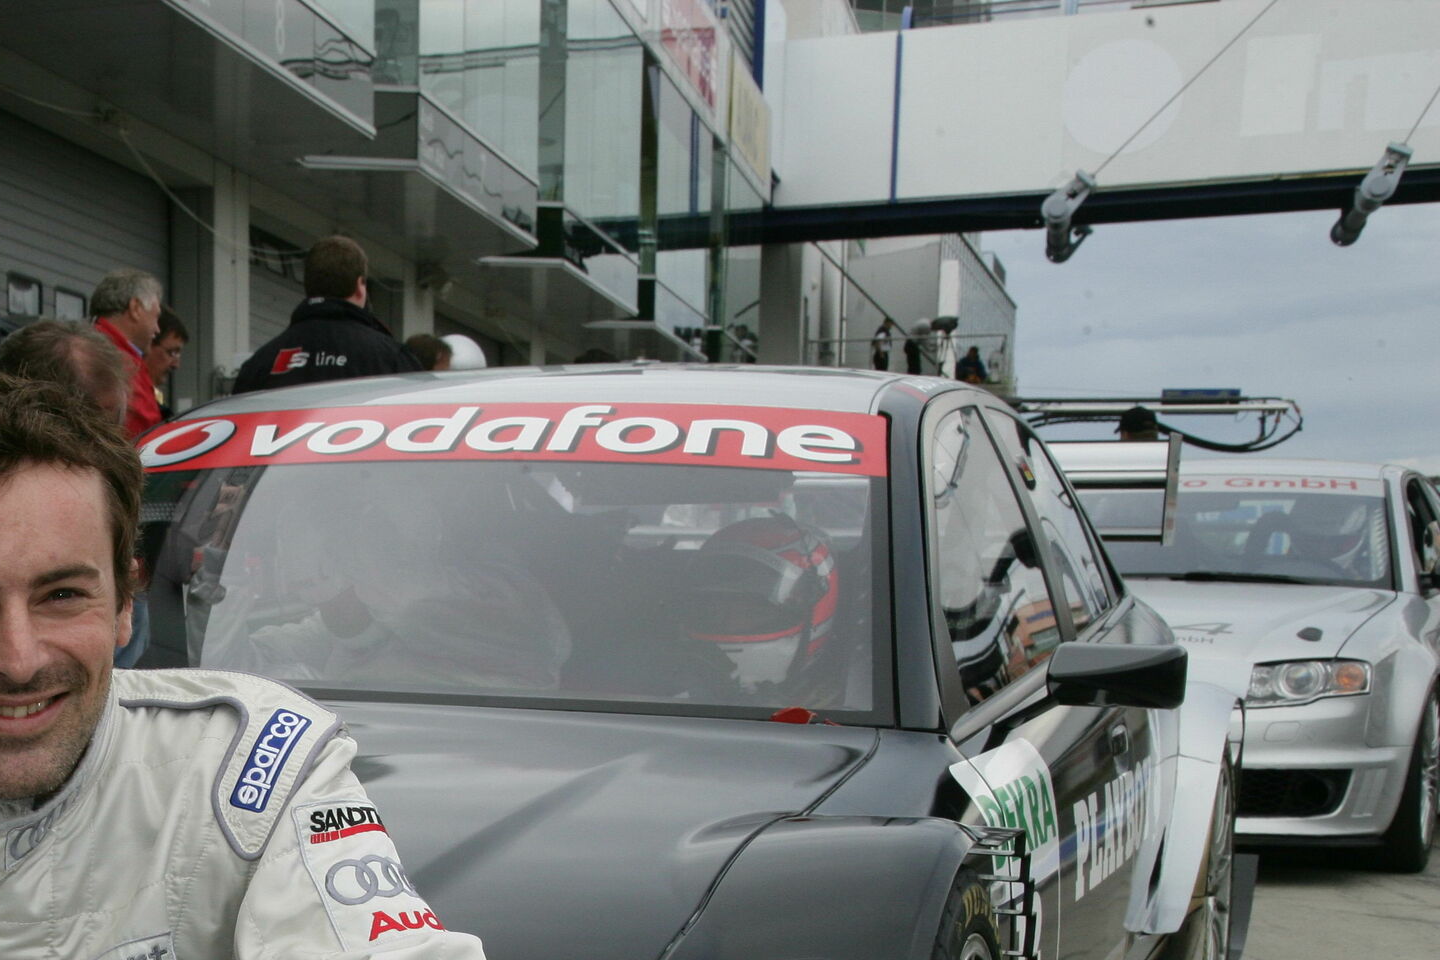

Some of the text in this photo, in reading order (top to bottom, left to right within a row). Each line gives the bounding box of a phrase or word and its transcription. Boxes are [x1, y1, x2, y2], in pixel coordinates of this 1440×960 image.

[315, 351, 348, 366] line
[250, 405, 859, 464] vodafone
[1224, 477, 1358, 490] GmbH
[237, 712, 302, 806] sparco
[369, 907, 446, 942] Aud
